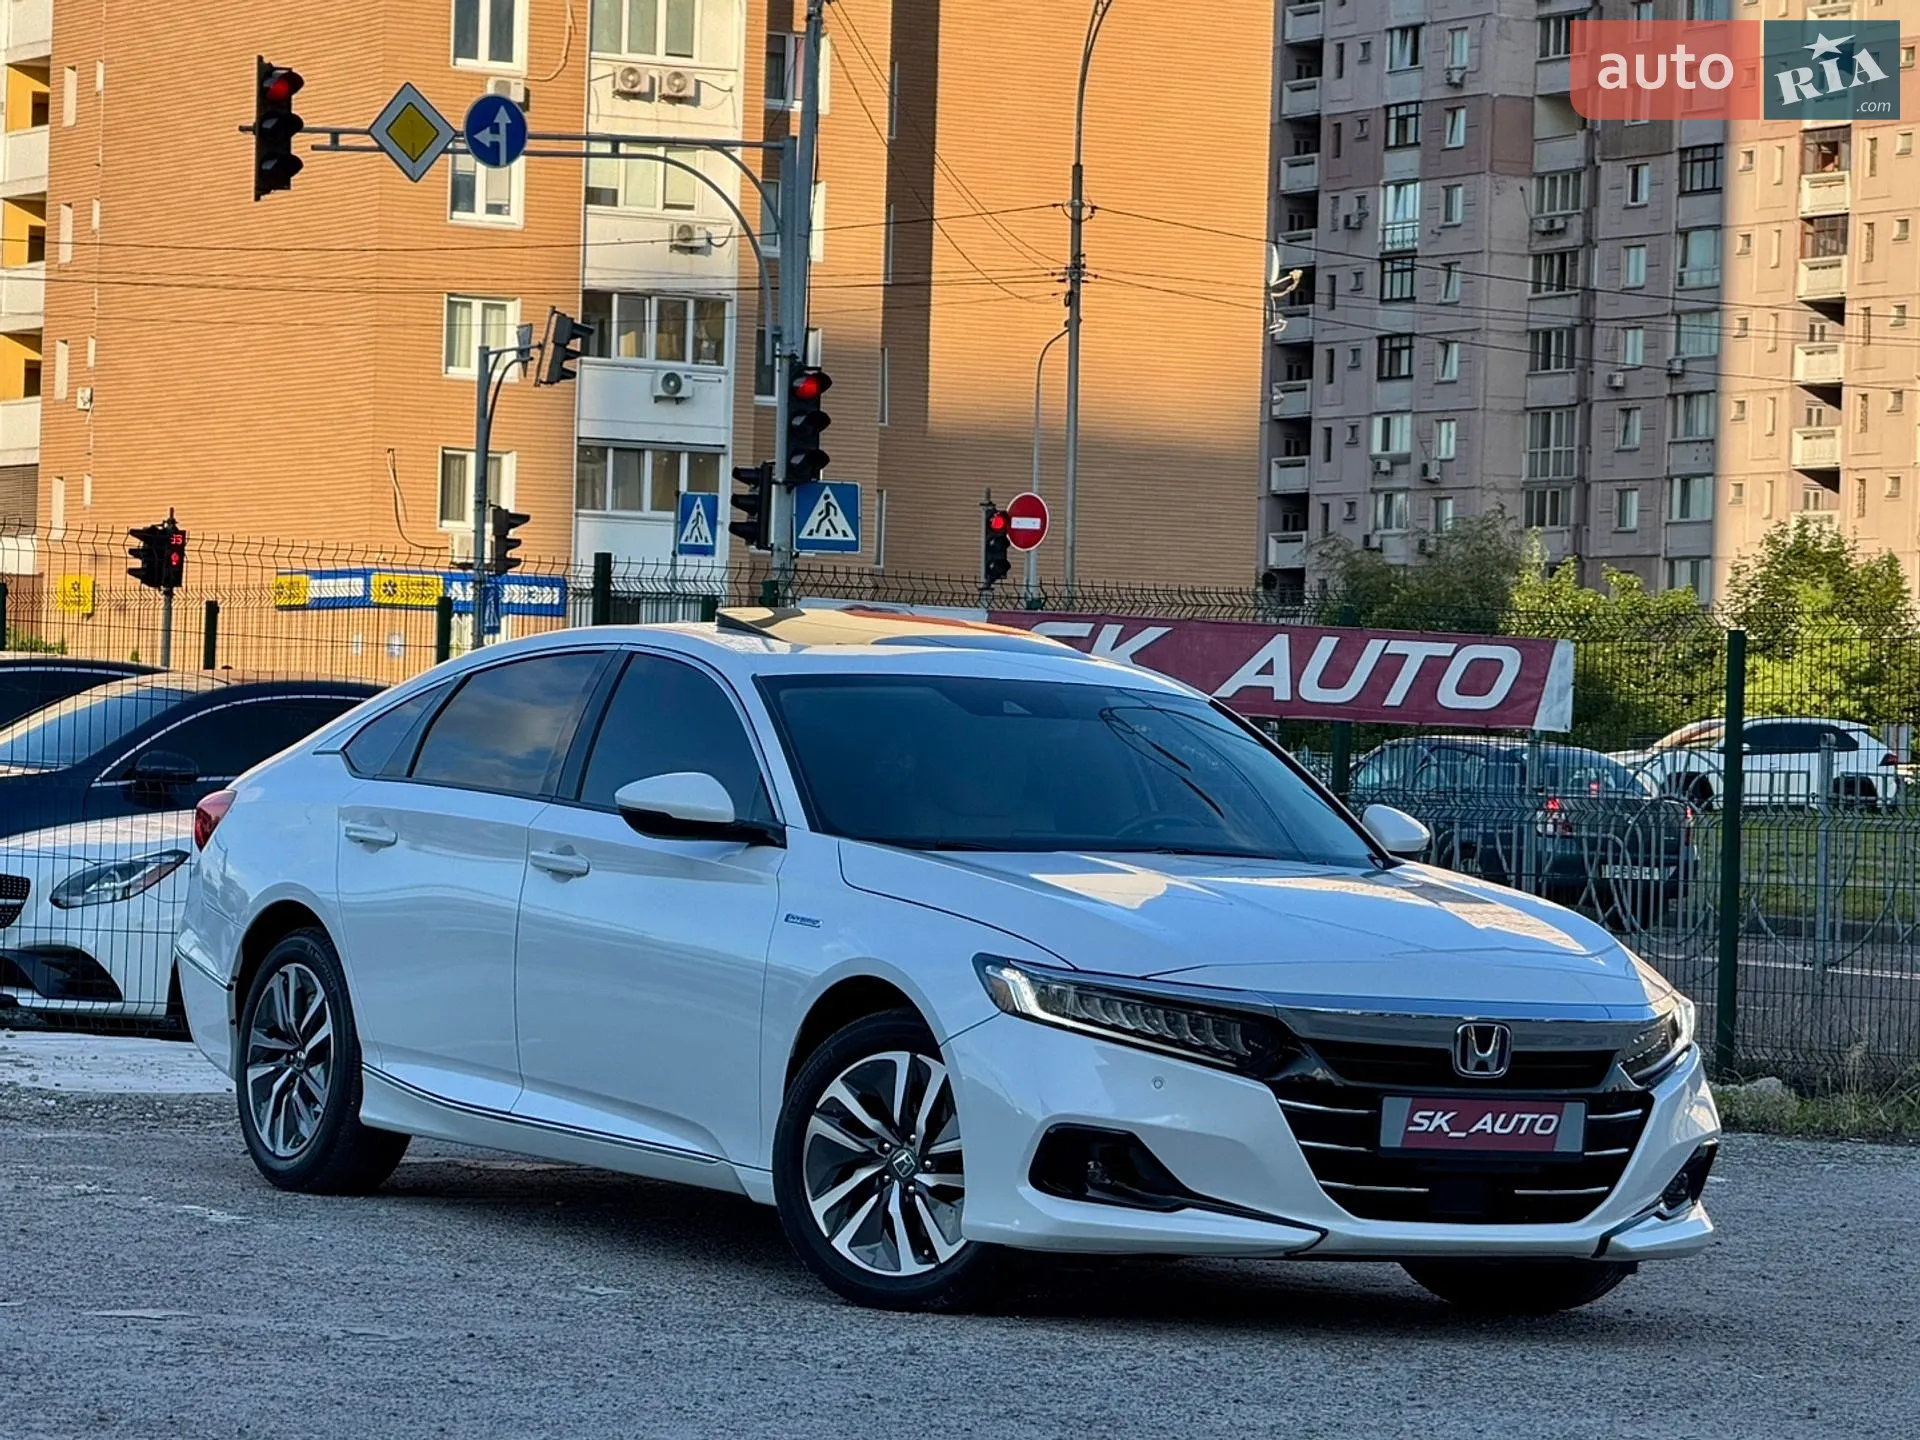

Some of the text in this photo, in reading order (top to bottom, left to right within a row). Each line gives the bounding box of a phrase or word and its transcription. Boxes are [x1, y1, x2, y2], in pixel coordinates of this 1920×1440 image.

[1031, 621, 1522, 711] K AUTO
[1407, 1110, 1560, 1138] SK_AUTO
